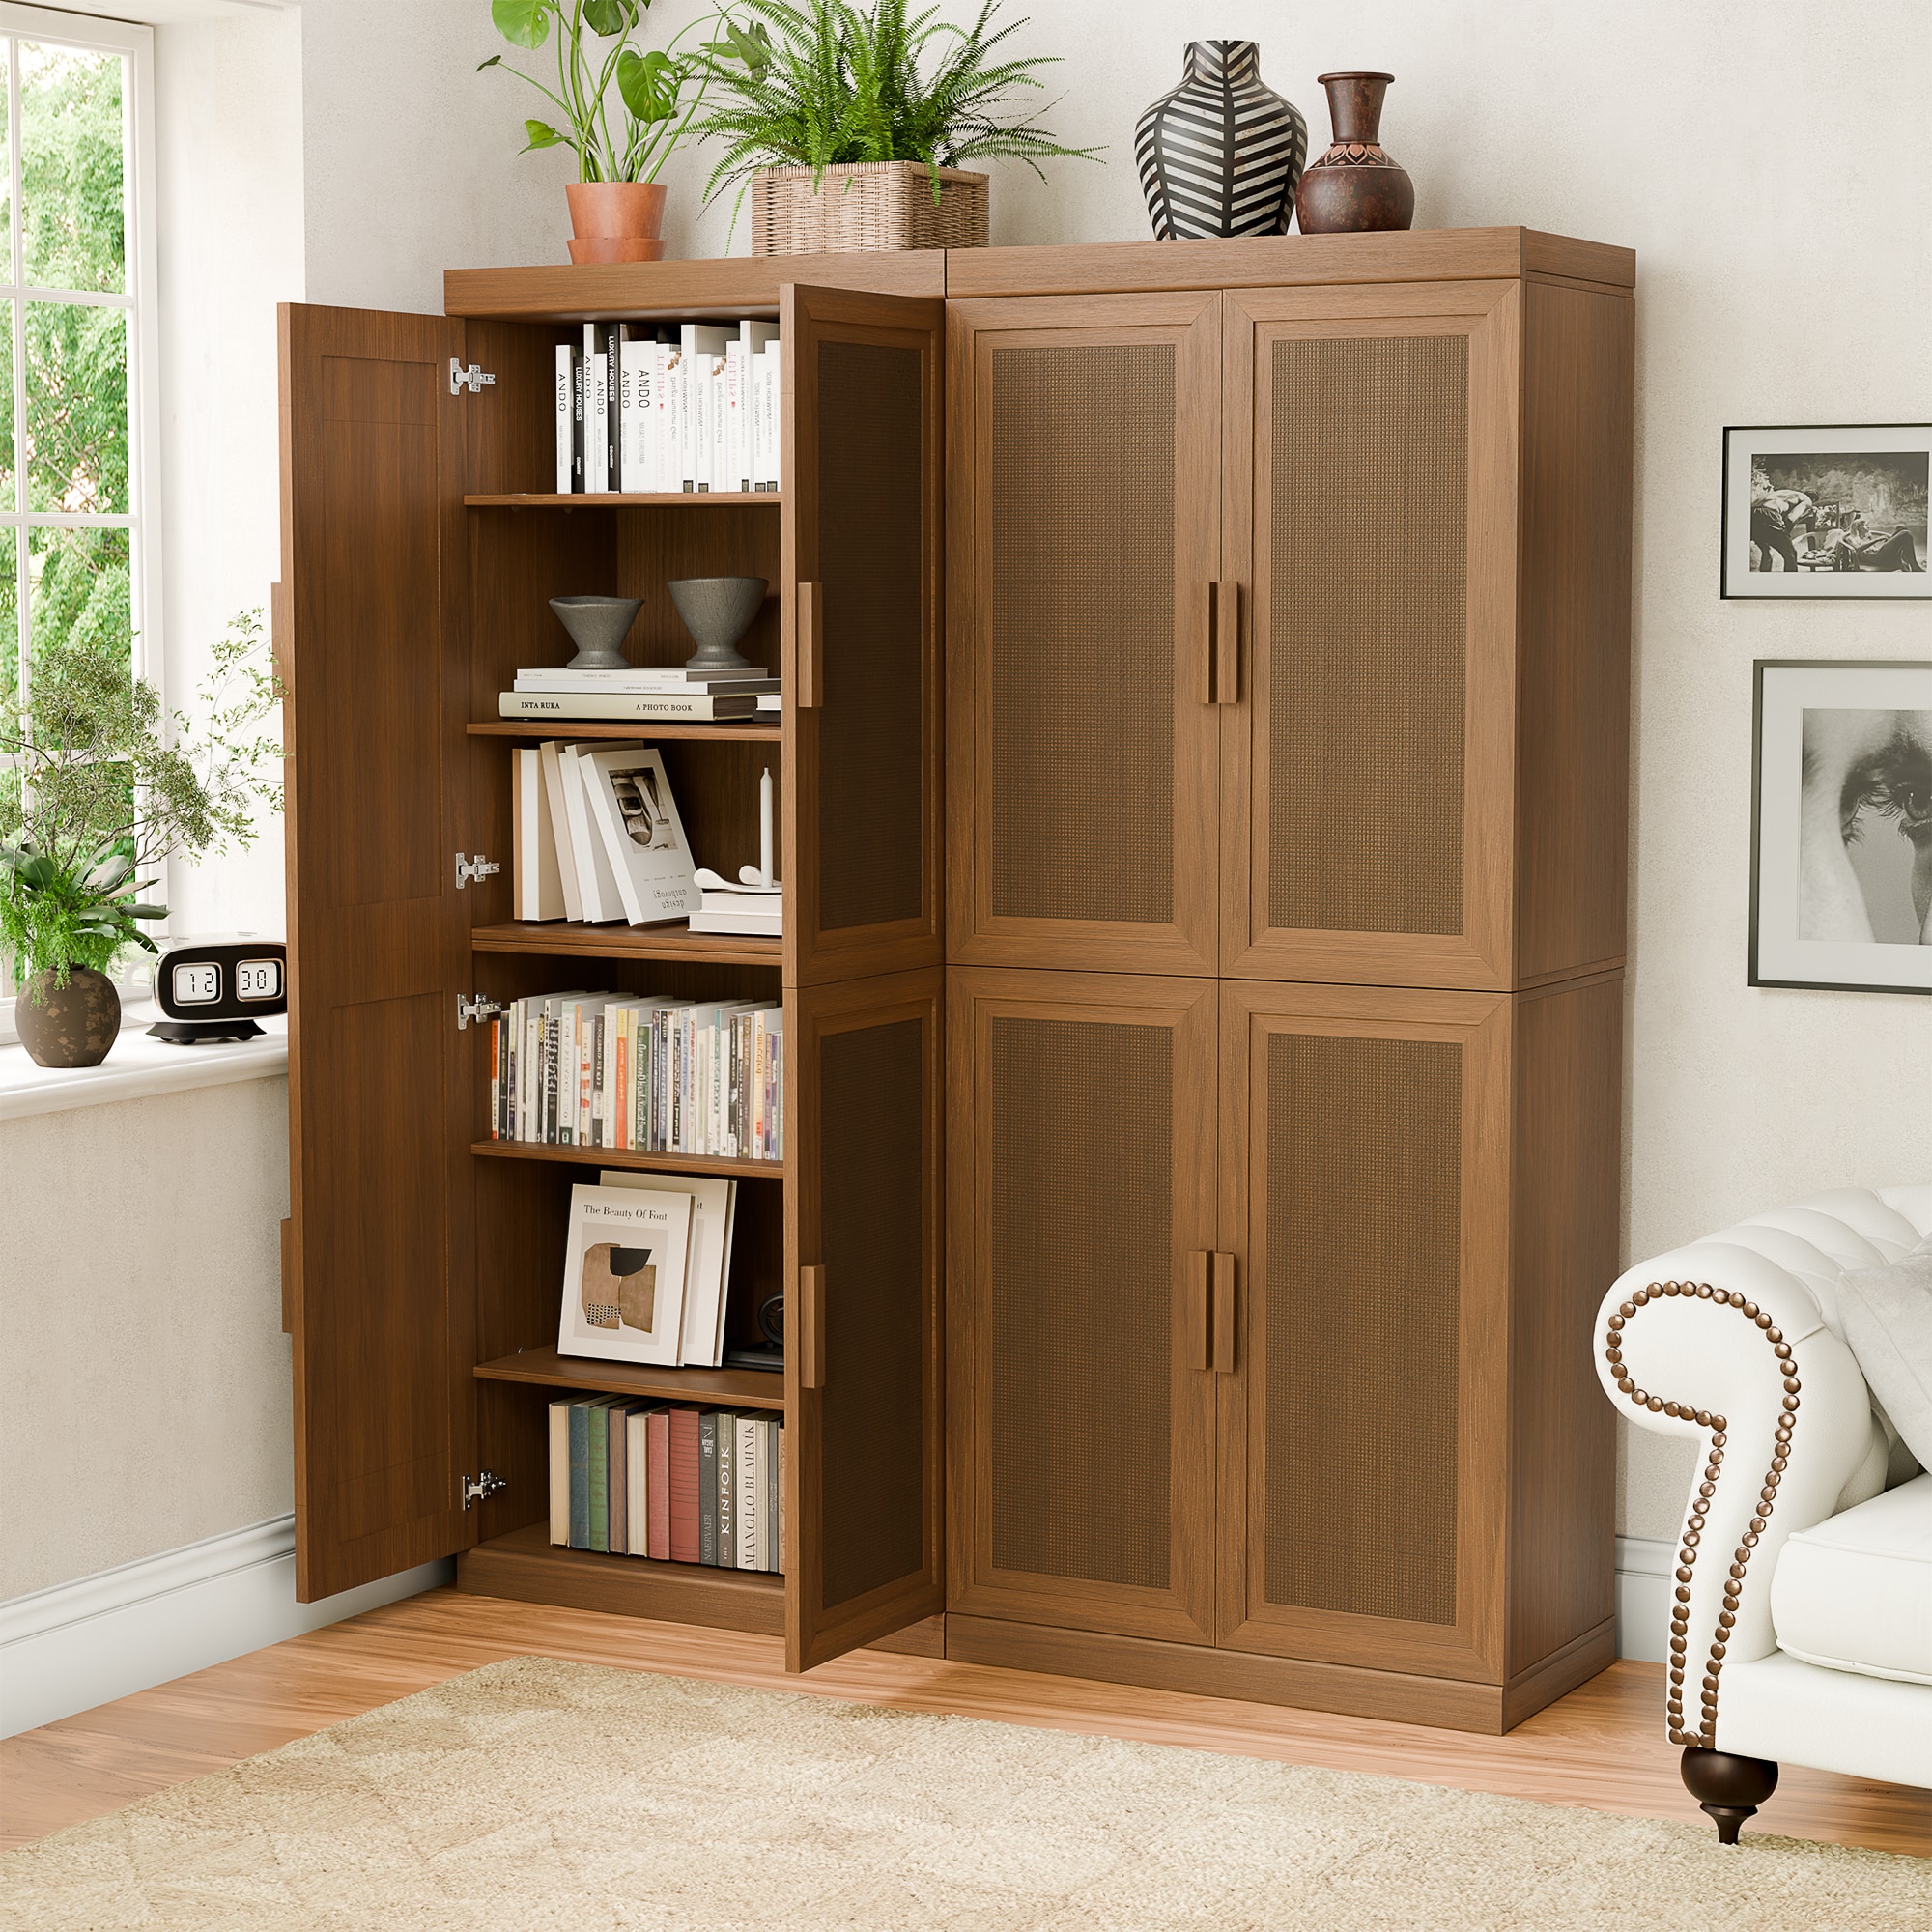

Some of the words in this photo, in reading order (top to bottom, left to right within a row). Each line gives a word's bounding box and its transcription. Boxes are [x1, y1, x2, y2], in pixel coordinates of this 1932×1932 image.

[639, 370, 650, 408] ANDO
[190, 973, 213, 992] 12
[242, 970, 266, 990] 30
[584, 1205, 601, 1215] The
[603, 1207, 633, 1220] Beauty
[636, 1209, 646, 1218] Of
[649, 1210, 668, 1221] Font
[721, 1446, 729, 1534] KINFOLK
[744, 1495, 755, 1565] MANOLO
